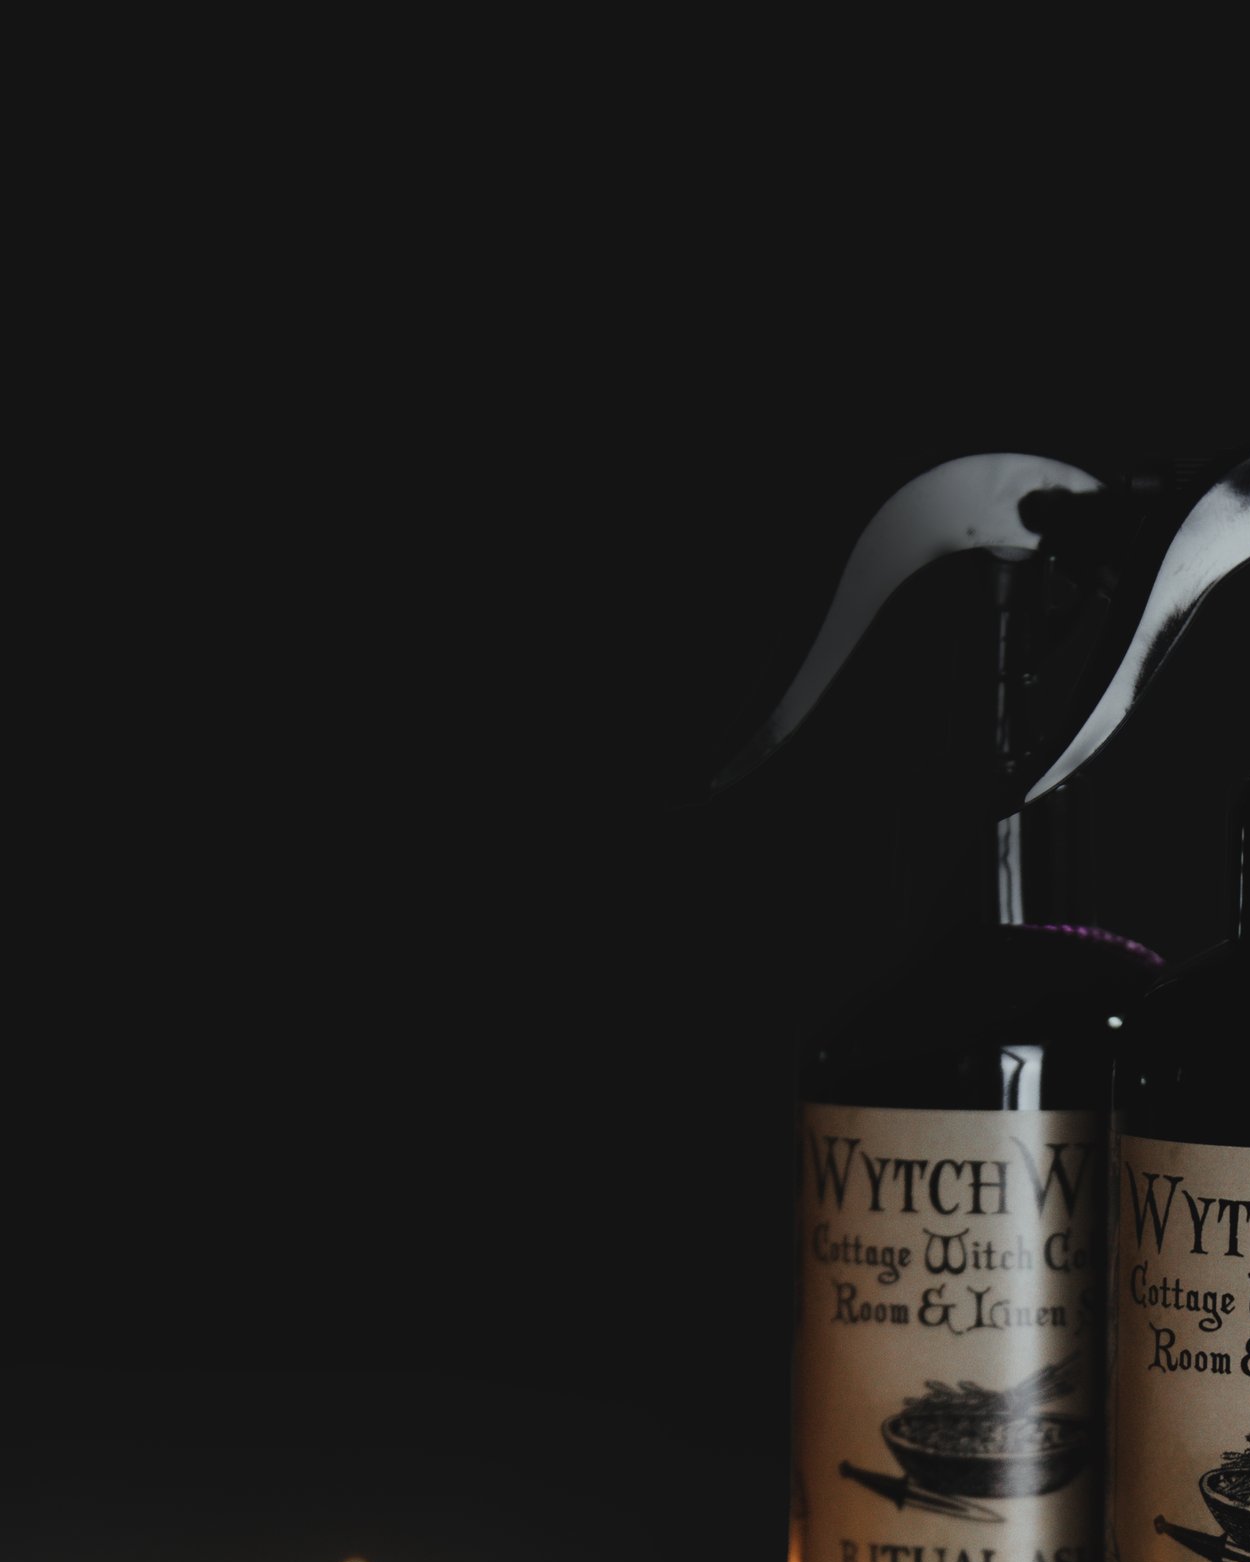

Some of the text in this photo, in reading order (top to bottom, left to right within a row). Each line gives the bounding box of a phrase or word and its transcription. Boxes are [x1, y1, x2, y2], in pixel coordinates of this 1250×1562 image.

[808, 1130, 1011, 1215] WYTCH
[812, 1220, 912, 1285] Cottage
[922, 1227, 1033, 1276] Witch
[831, 1280, 911, 1328] Room
[917, 1283, 964, 1335] &
[966, 1285, 1067, 1332] Linen
[1130, 1260, 1236, 1332] Cottage
[1148, 1322, 1231, 1376] Room
